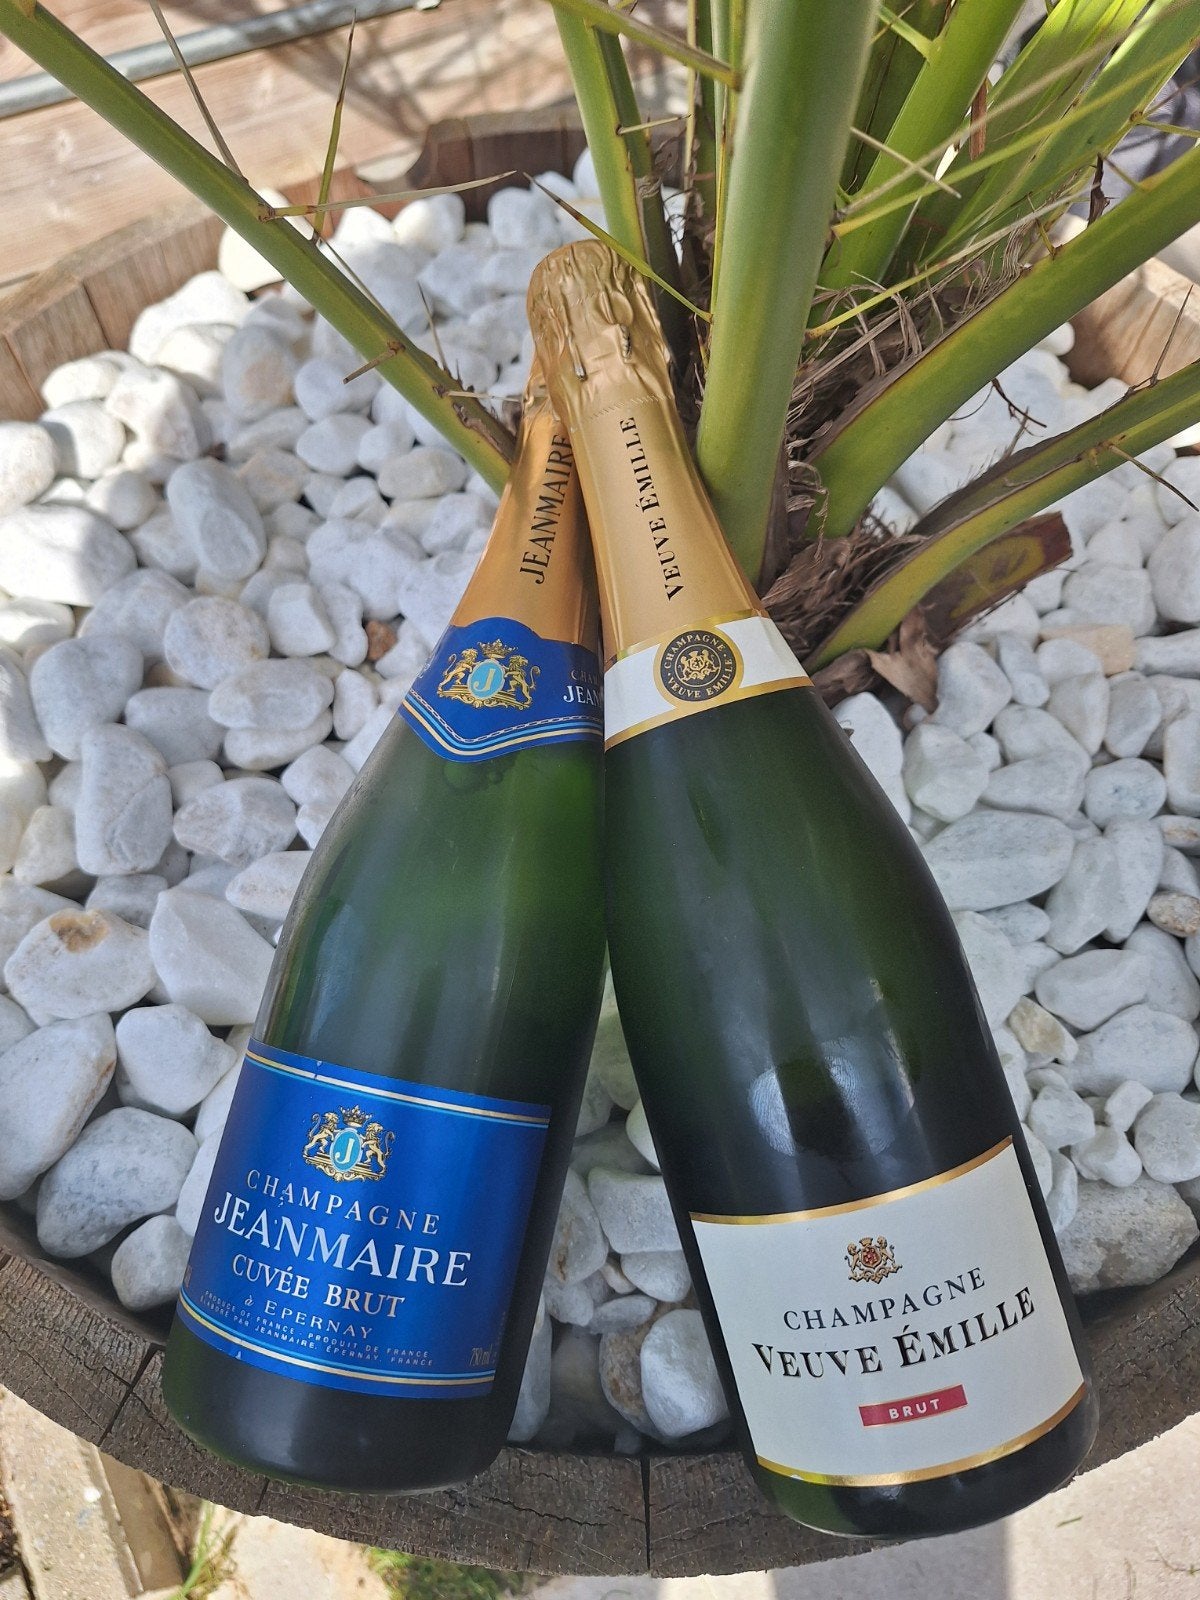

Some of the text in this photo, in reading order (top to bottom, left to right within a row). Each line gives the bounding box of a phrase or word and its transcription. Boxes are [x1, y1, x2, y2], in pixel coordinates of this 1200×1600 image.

[519, 434, 573, 585] JEANMAIRE
[619, 416, 684, 601] VEUVE ÉMILLE
[664, 634, 726, 669] CHAMPAGNE
[473, 669, 496, 692] J
[668, 677, 701, 698] VEUVE
[334, 1138, 354, 1164] J
[247, 1168, 441, 1236] CHAMPAGNE
[214, 1191, 472, 1287] JEANMAIRE
[232, 1253, 310, 1299] CUVÉE
[324, 1283, 405, 1318] BRUT
[783, 1267, 986, 1331] CHAMPAGNE
[233, 1315, 250, 1327] PAR
[391, 1357, 433, 1366] FRANCE
[240, 1309, 251, 1319] OF
[256, 1316, 295, 1335] FRANCE
[308, 1333, 358, 1349] PRODUIT
[366, 1345, 379, 1353] DE
[386, 1347, 429, 1358] FRANCE
[264, 1300, 373, 1339] EPERNAY
[751, 1286, 1037, 1378] VEUVE ÉMILLE
[888, 1398, 941, 1420] BRUT
